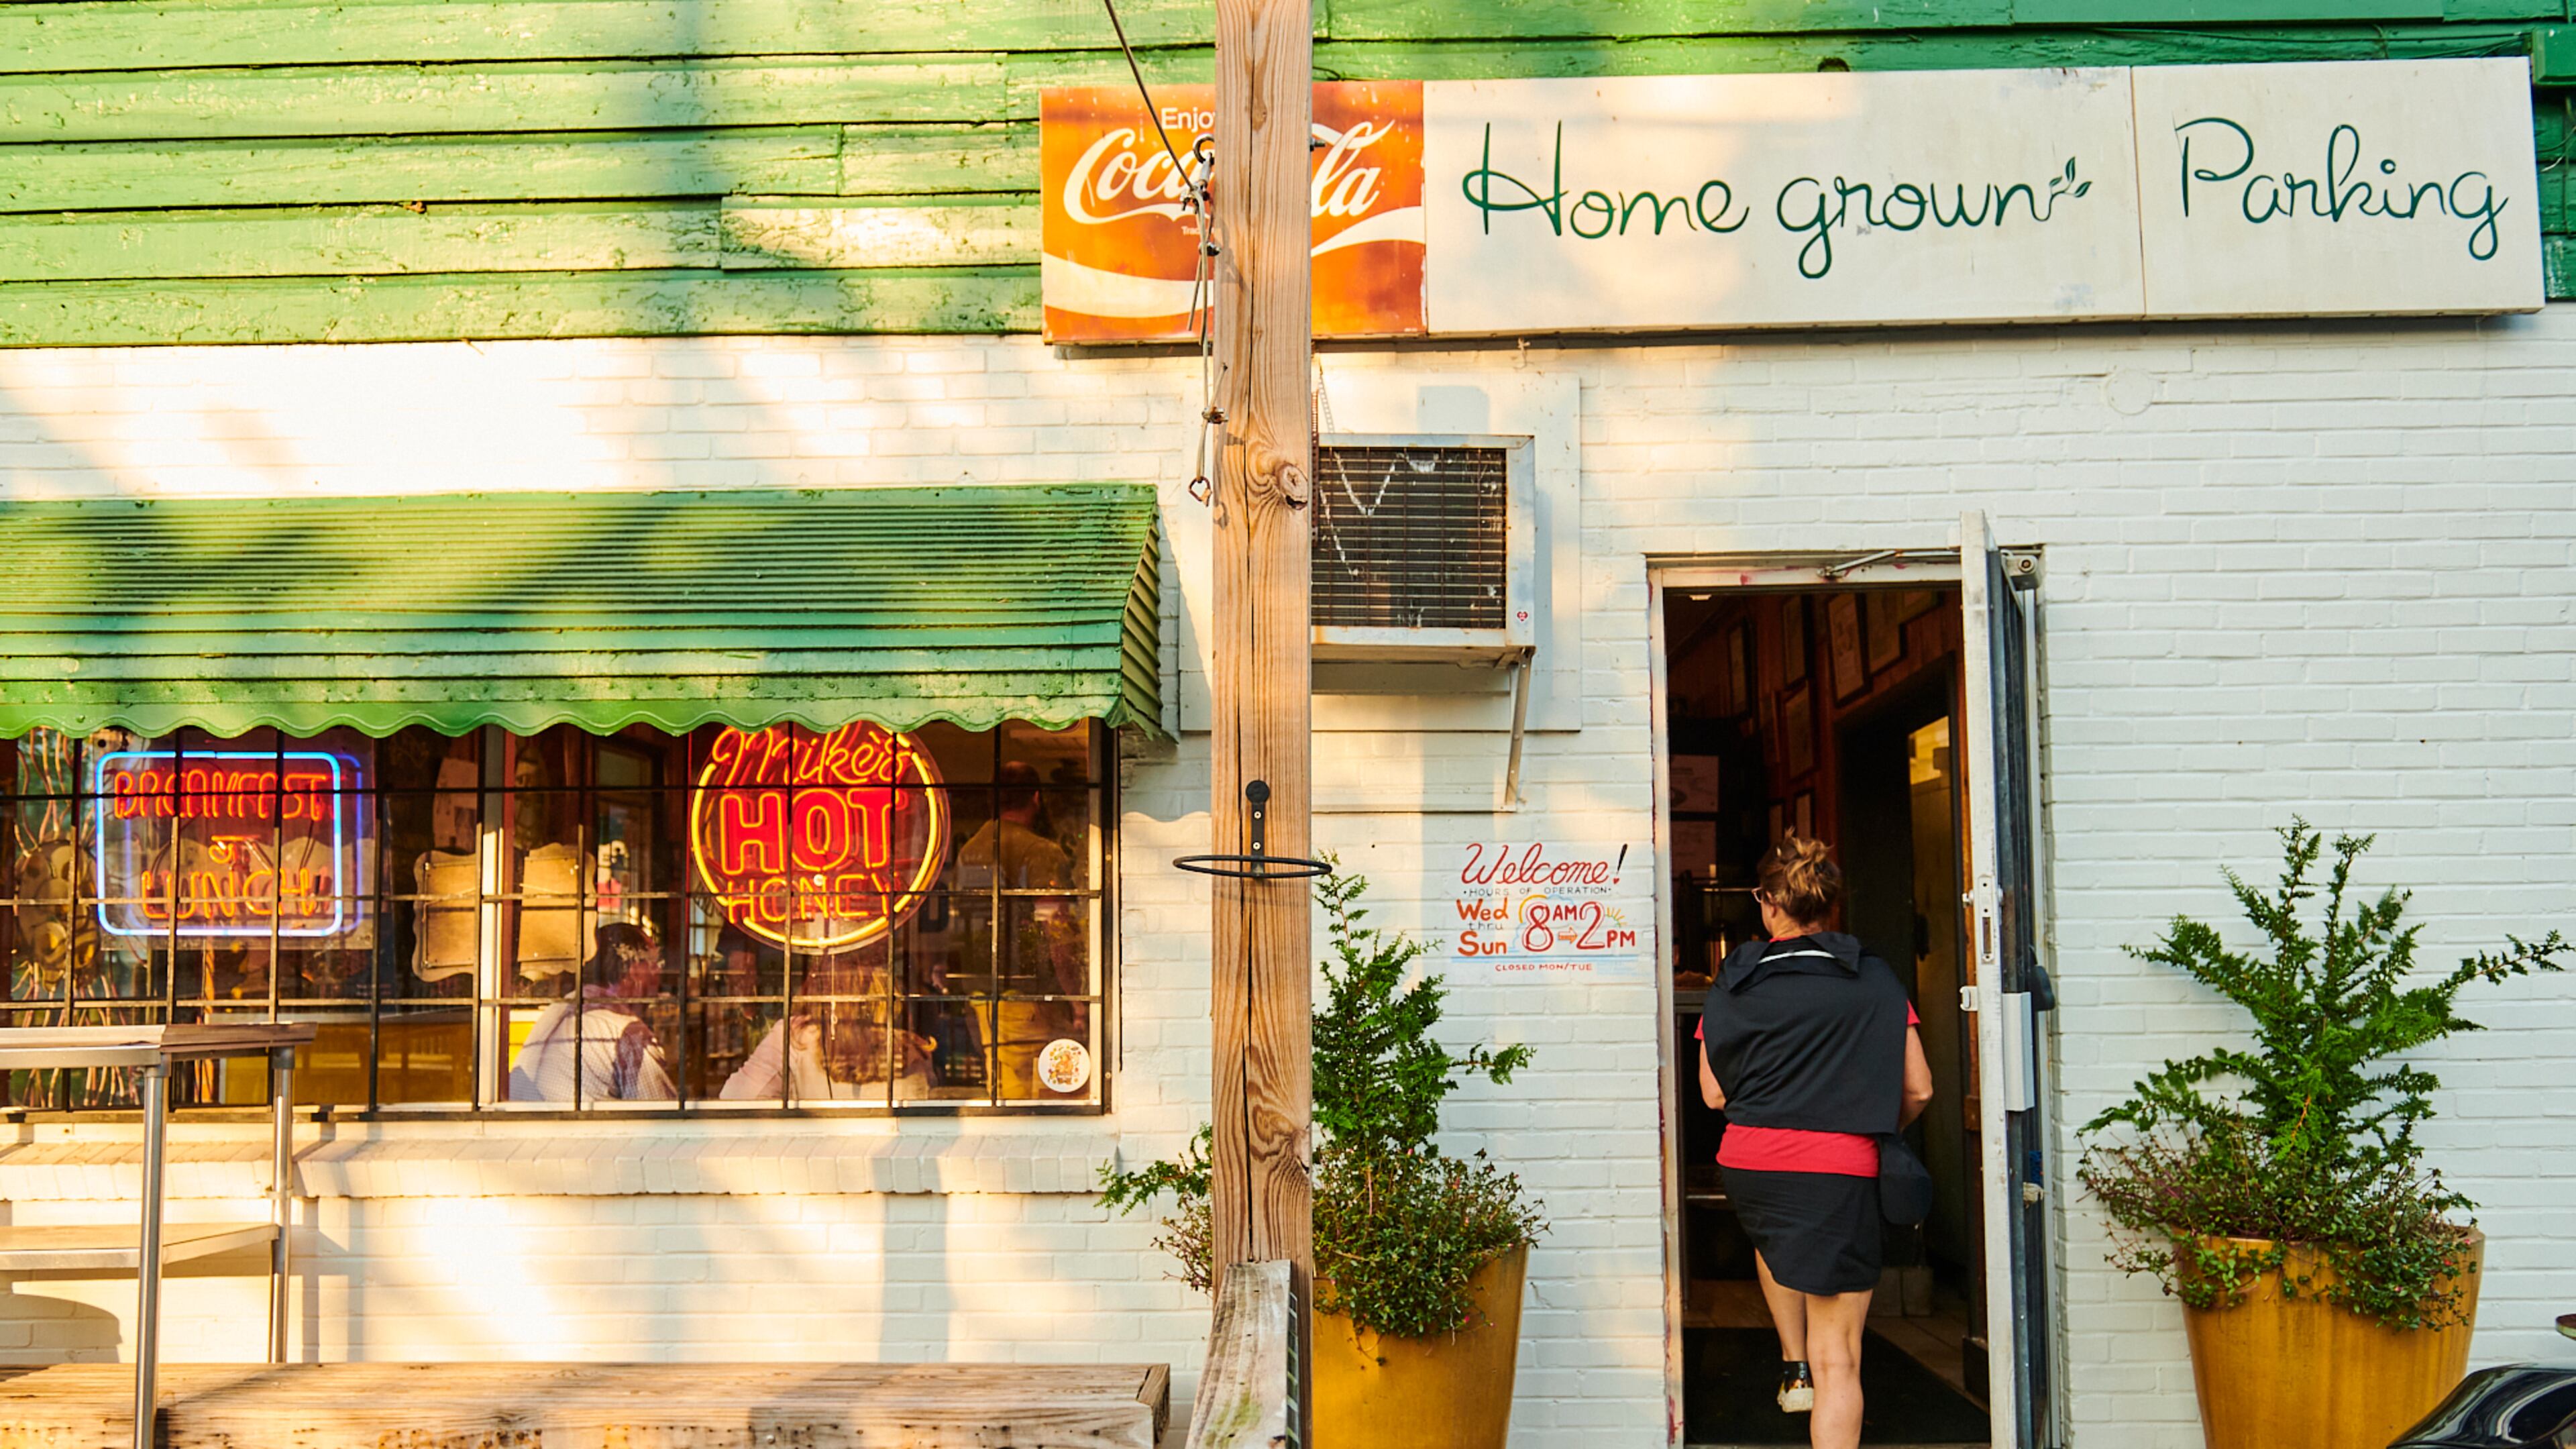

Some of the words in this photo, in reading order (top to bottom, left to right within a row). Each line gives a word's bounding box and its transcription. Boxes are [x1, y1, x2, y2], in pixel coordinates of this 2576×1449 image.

[1161, 107, 1216, 133] Enjo
[1462, 119, 1750, 239] Home
[1776, 176, 2054, 279] grown
[2174, 116, 2510, 261] Parking
[712, 722, 912, 786] Mike's
[720, 788, 902, 875] HOT
[142, 867, 319, 919] LUNCH
[728, 873, 893, 924] HONEY
[1456, 897, 1509, 922] Wed
[1468, 888, 1510, 897] HOURS
[1544, 887, 1608, 895] OPERATION
[1457, 930, 1507, 957] Sun
[1468, 922, 1504, 931] thru
[1495, 964, 1536, 972] CLOSED
